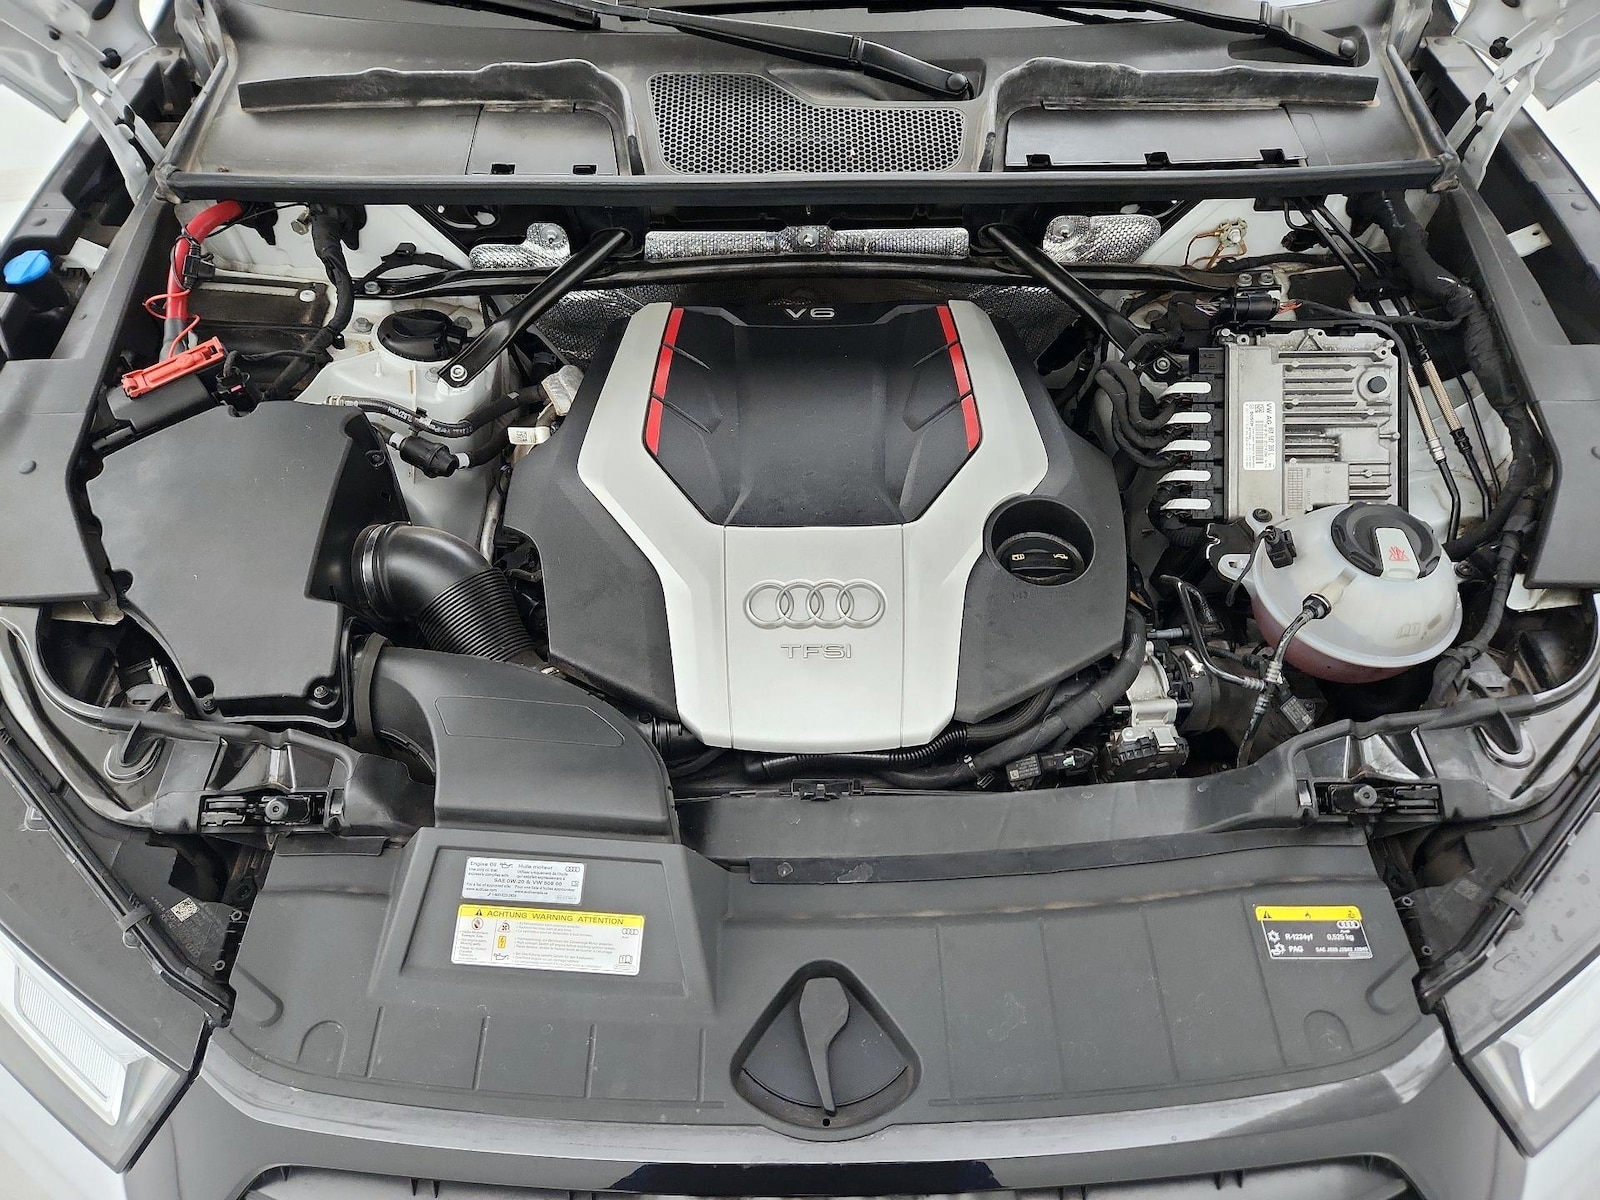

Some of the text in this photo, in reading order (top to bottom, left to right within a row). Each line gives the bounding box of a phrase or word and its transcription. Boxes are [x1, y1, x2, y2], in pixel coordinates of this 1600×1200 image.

[785, 307, 835, 318] V6
[1266, 402, 1272, 414] VW
[1266, 415, 1272, 425] AG
[780, 643, 852, 660] TFSI
[486, 910, 624, 925] ACHTUNG WARNING ATTENTION
[1288, 945, 1304, 953] PAG
